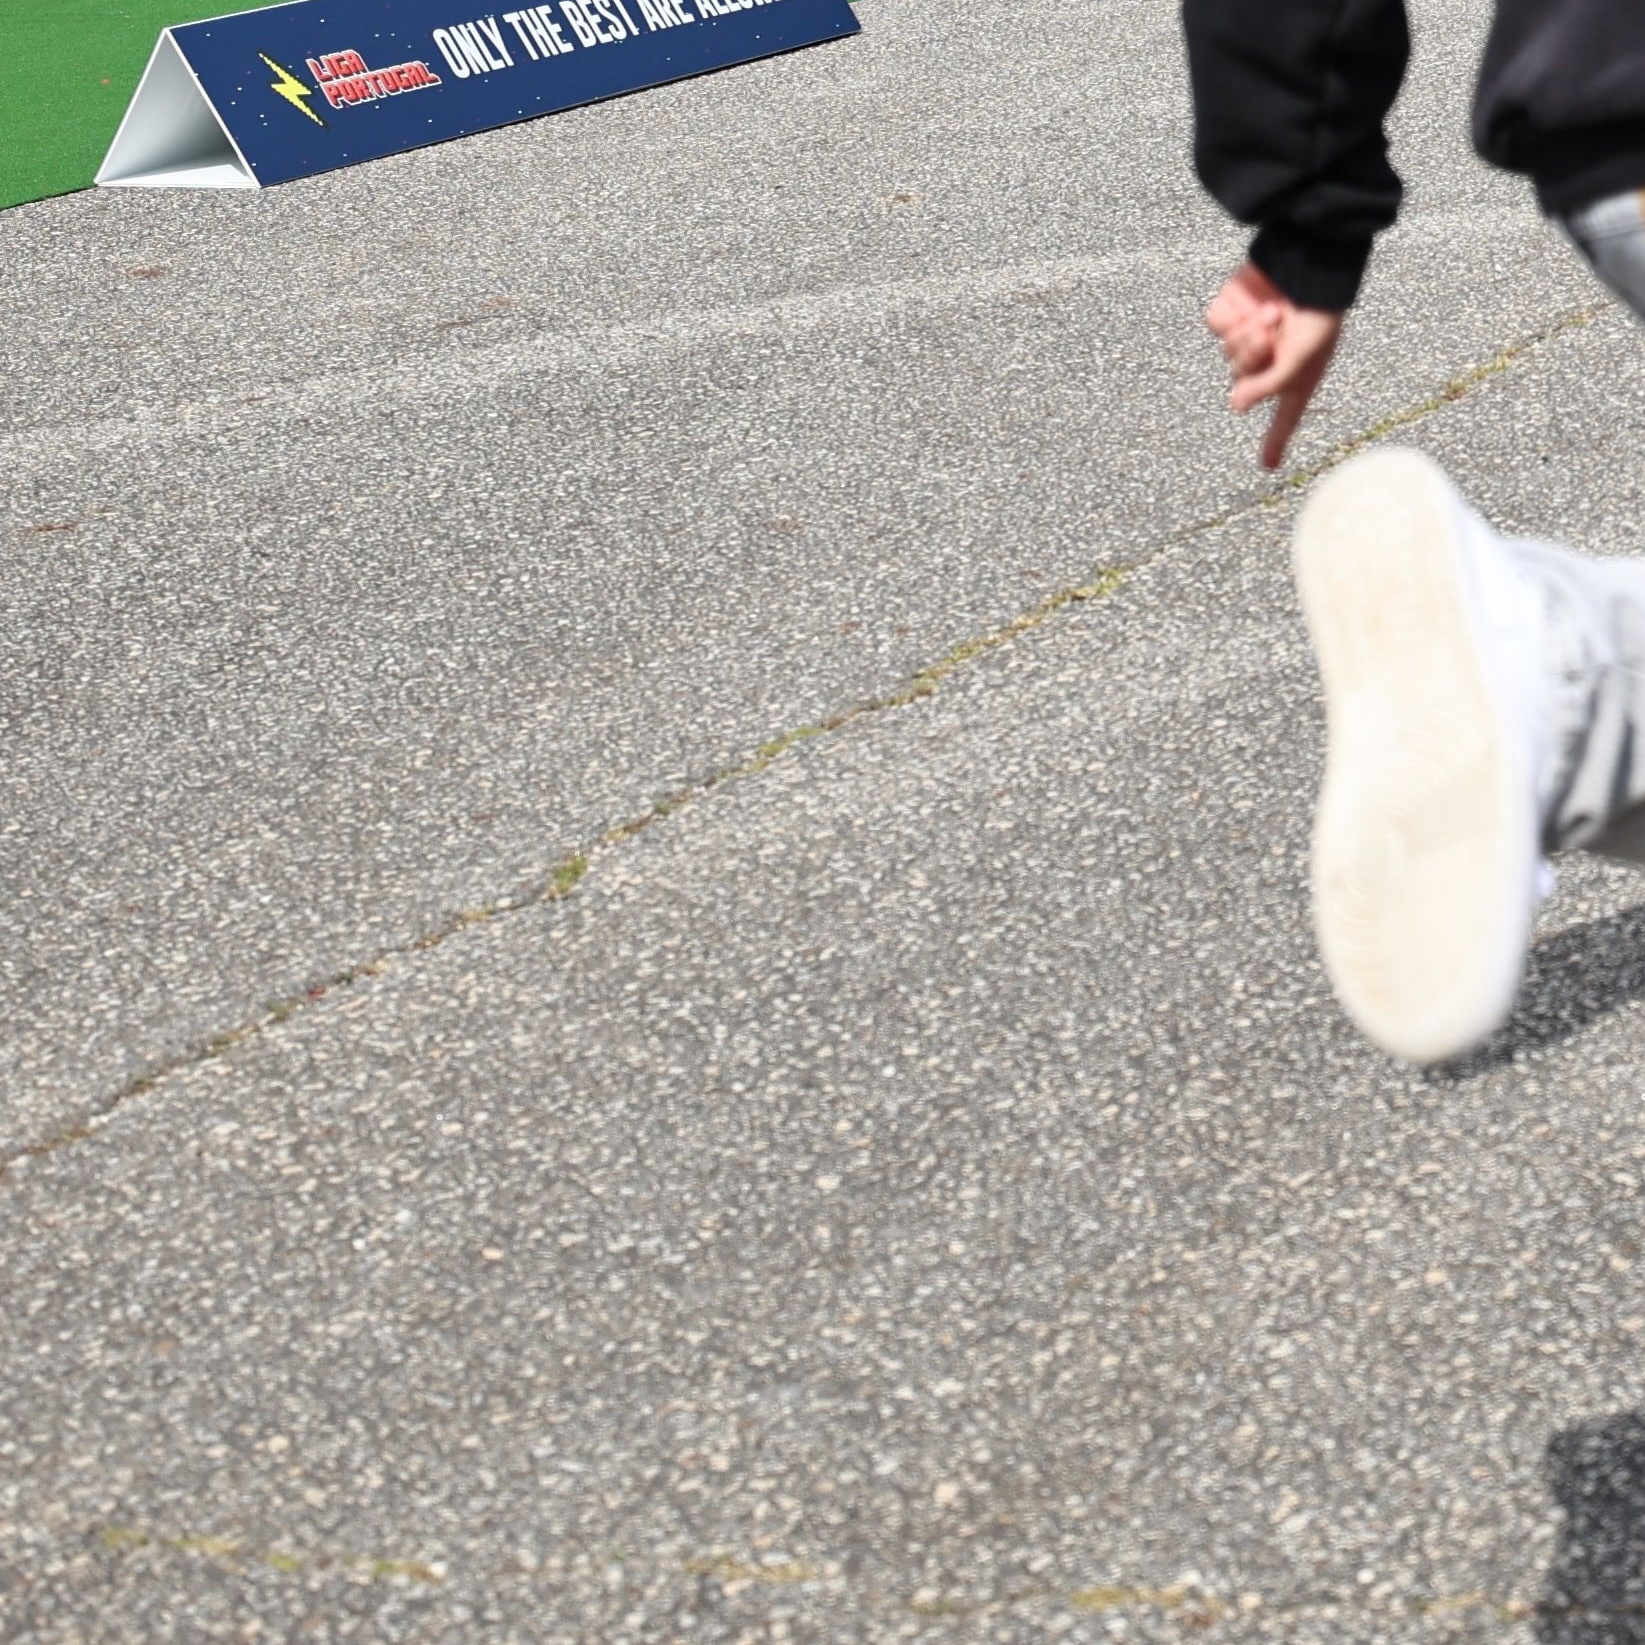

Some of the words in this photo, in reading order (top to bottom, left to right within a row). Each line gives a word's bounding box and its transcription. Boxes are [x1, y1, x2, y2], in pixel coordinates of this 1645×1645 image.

[432, 17, 514, 79] ONLY
[502, 4, 575, 60] THE
[305, 49, 369, 84] LIGA
[319, 60, 442, 109] PORTUGAL
